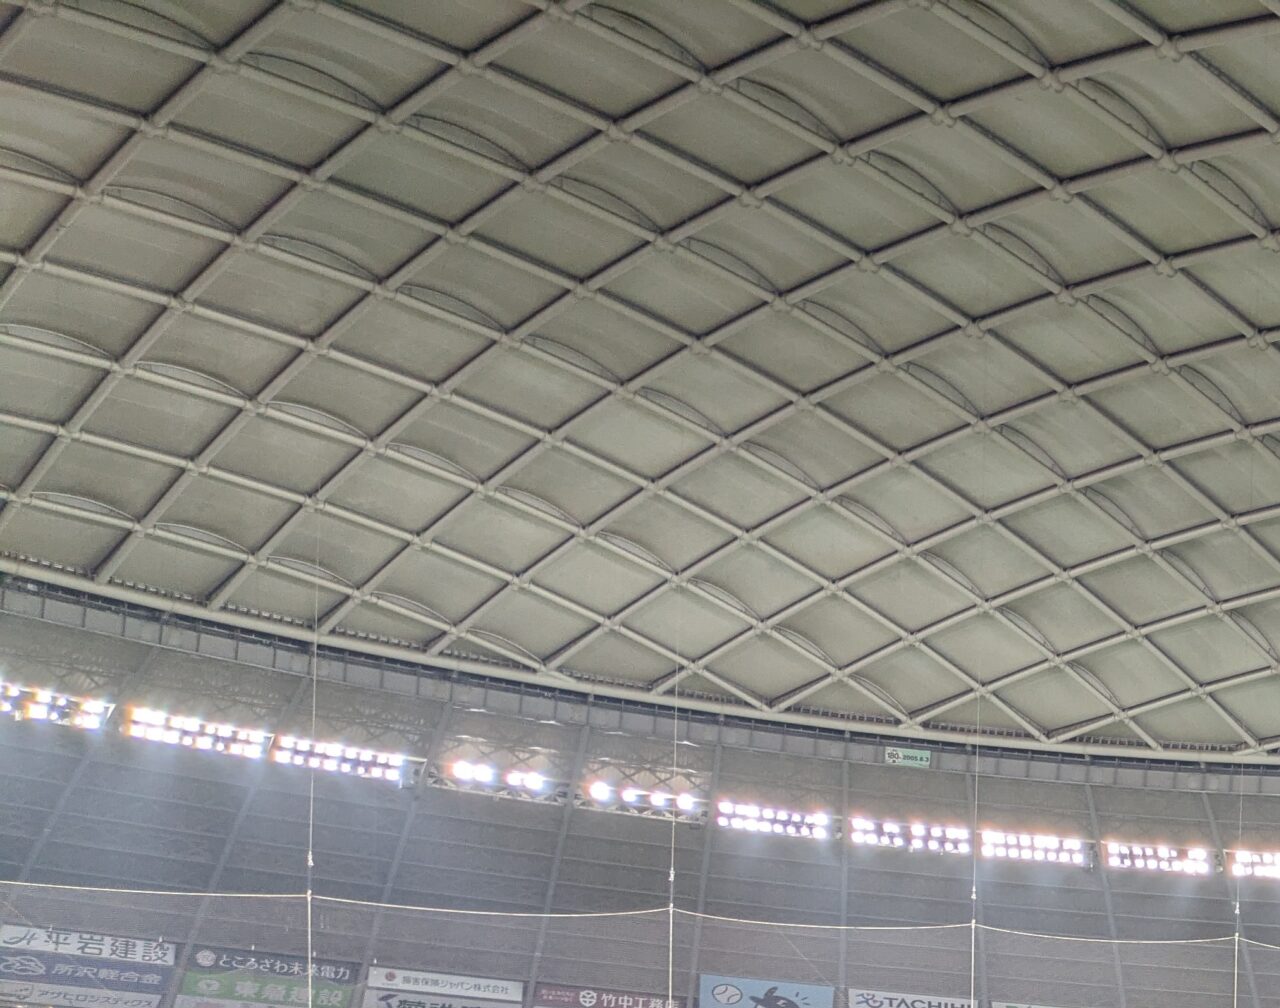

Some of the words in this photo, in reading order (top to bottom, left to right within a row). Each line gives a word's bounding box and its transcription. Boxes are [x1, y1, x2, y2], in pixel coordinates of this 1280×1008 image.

[44, 929, 170, 964] 平岩建設
[52, 963, 163, 986] 所沢軽合金
[219, 954, 351, 981] ところざわ未来電力
